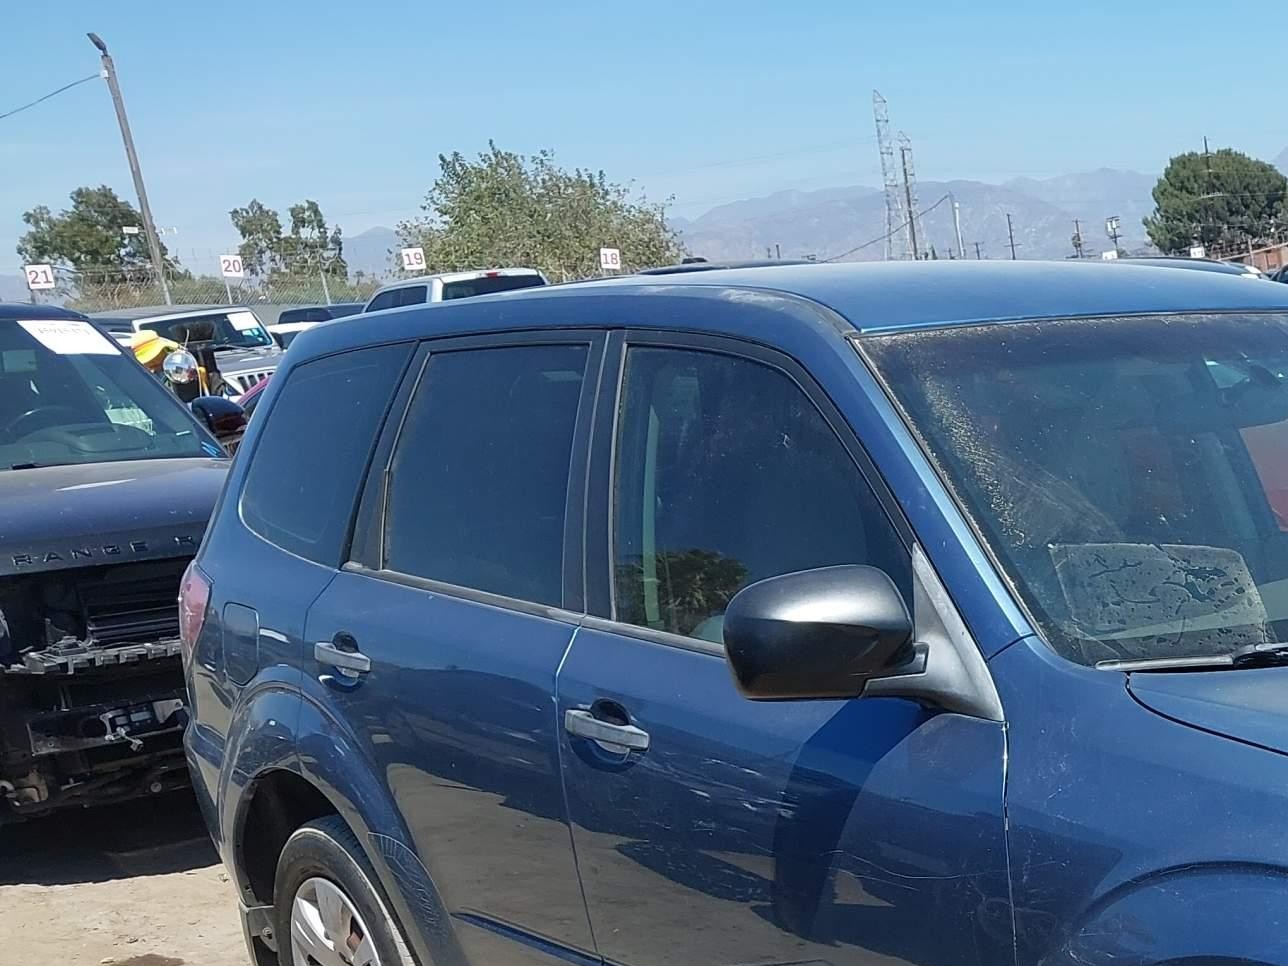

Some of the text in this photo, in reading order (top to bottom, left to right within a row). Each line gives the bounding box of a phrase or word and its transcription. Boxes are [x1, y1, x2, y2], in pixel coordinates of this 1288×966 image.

[222, 259, 243, 273] 20
[404, 252, 424, 266] 19
[602, 252, 619, 266] 18
[28, 270, 53, 285] 21
[11, 539, 148, 567] RANGE
